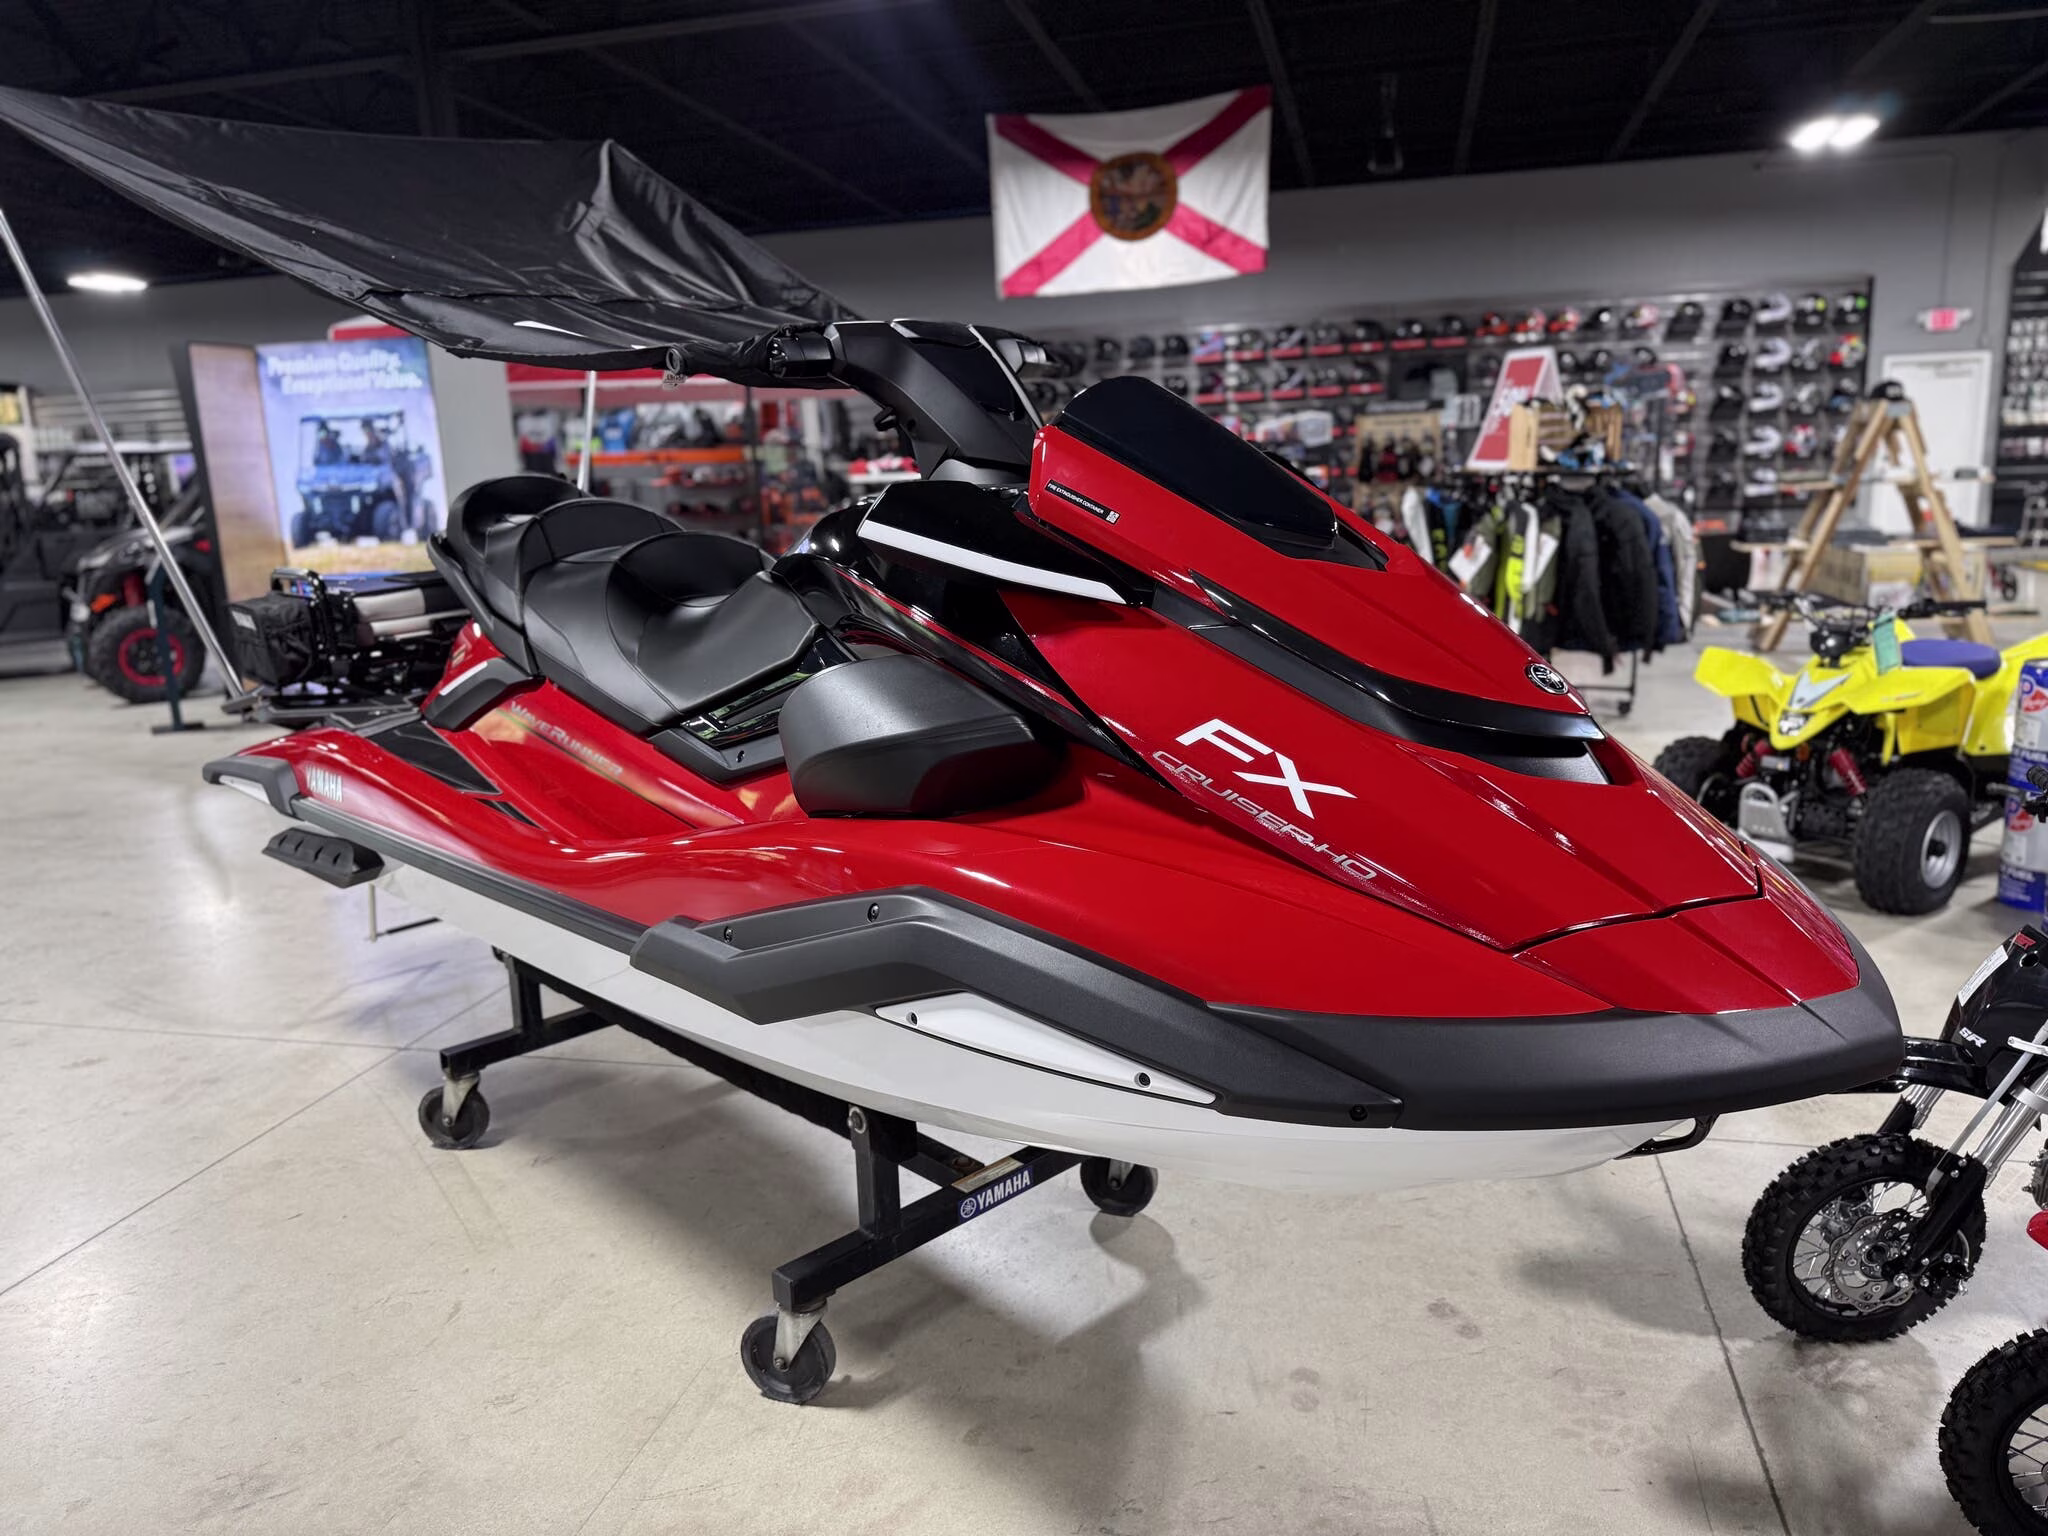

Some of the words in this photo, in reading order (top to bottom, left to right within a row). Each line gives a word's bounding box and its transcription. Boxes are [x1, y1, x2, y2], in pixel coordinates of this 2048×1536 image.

[1047, 483, 1057, 491] FIRE
[1056, 487, 1083, 504] EXTINGUISHER
[1082, 500, 1104, 514] CONTAINER
[304, 765, 343, 803] YAMAHA
[1175, 718, 1358, 820] FX
[1152, 750, 1316, 849] CRUISER
[977, 1170, 1031, 1210] YAMAHA
